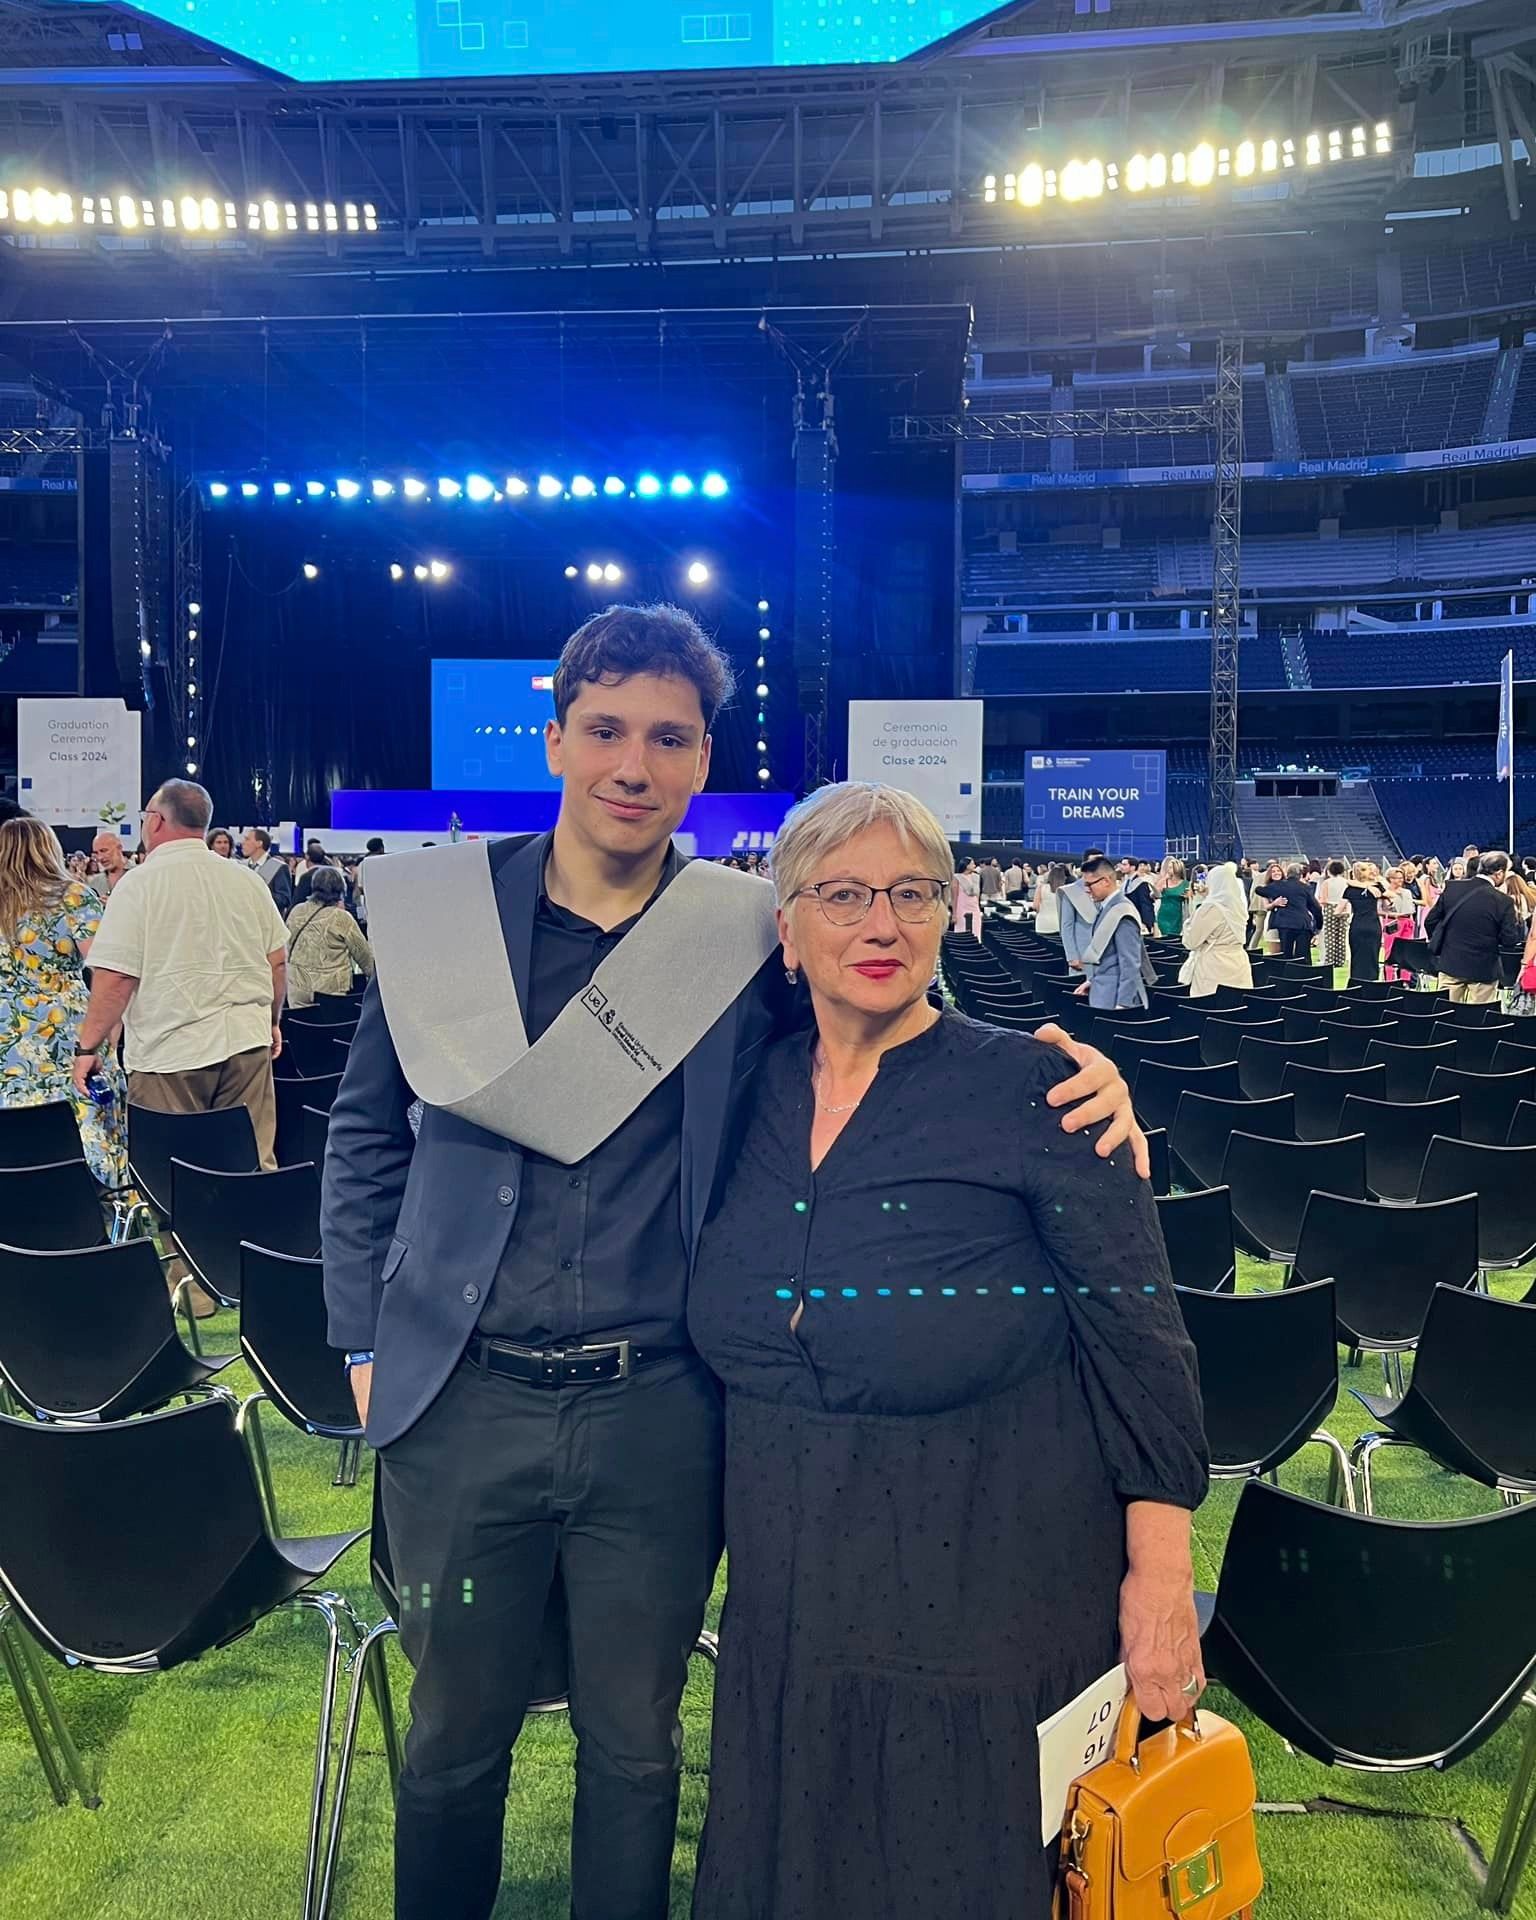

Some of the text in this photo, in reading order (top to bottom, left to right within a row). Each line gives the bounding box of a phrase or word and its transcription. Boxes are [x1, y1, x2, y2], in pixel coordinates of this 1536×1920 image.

[1441, 444, 1520, 463] Real Madrid
[1299, 457, 1368, 472] Real Madrid
[1031, 471, 1096, 485] Real Madrid
[1161, 470, 1187, 480] Real
[42, 479, 65, 490] Real
[47, 719, 110, 730] Graduation
[882, 721, 948, 732] Ceremonia
[50, 733, 107, 745] Ceremony
[872, 734, 958, 749] de graduación
[49, 751, 108, 761] Class 2024
[882, 755, 948, 765] Clase 2024
[1047, 787, 1140, 801] TRAIN YOUR
[1062, 805, 1126, 819] DREAMS
